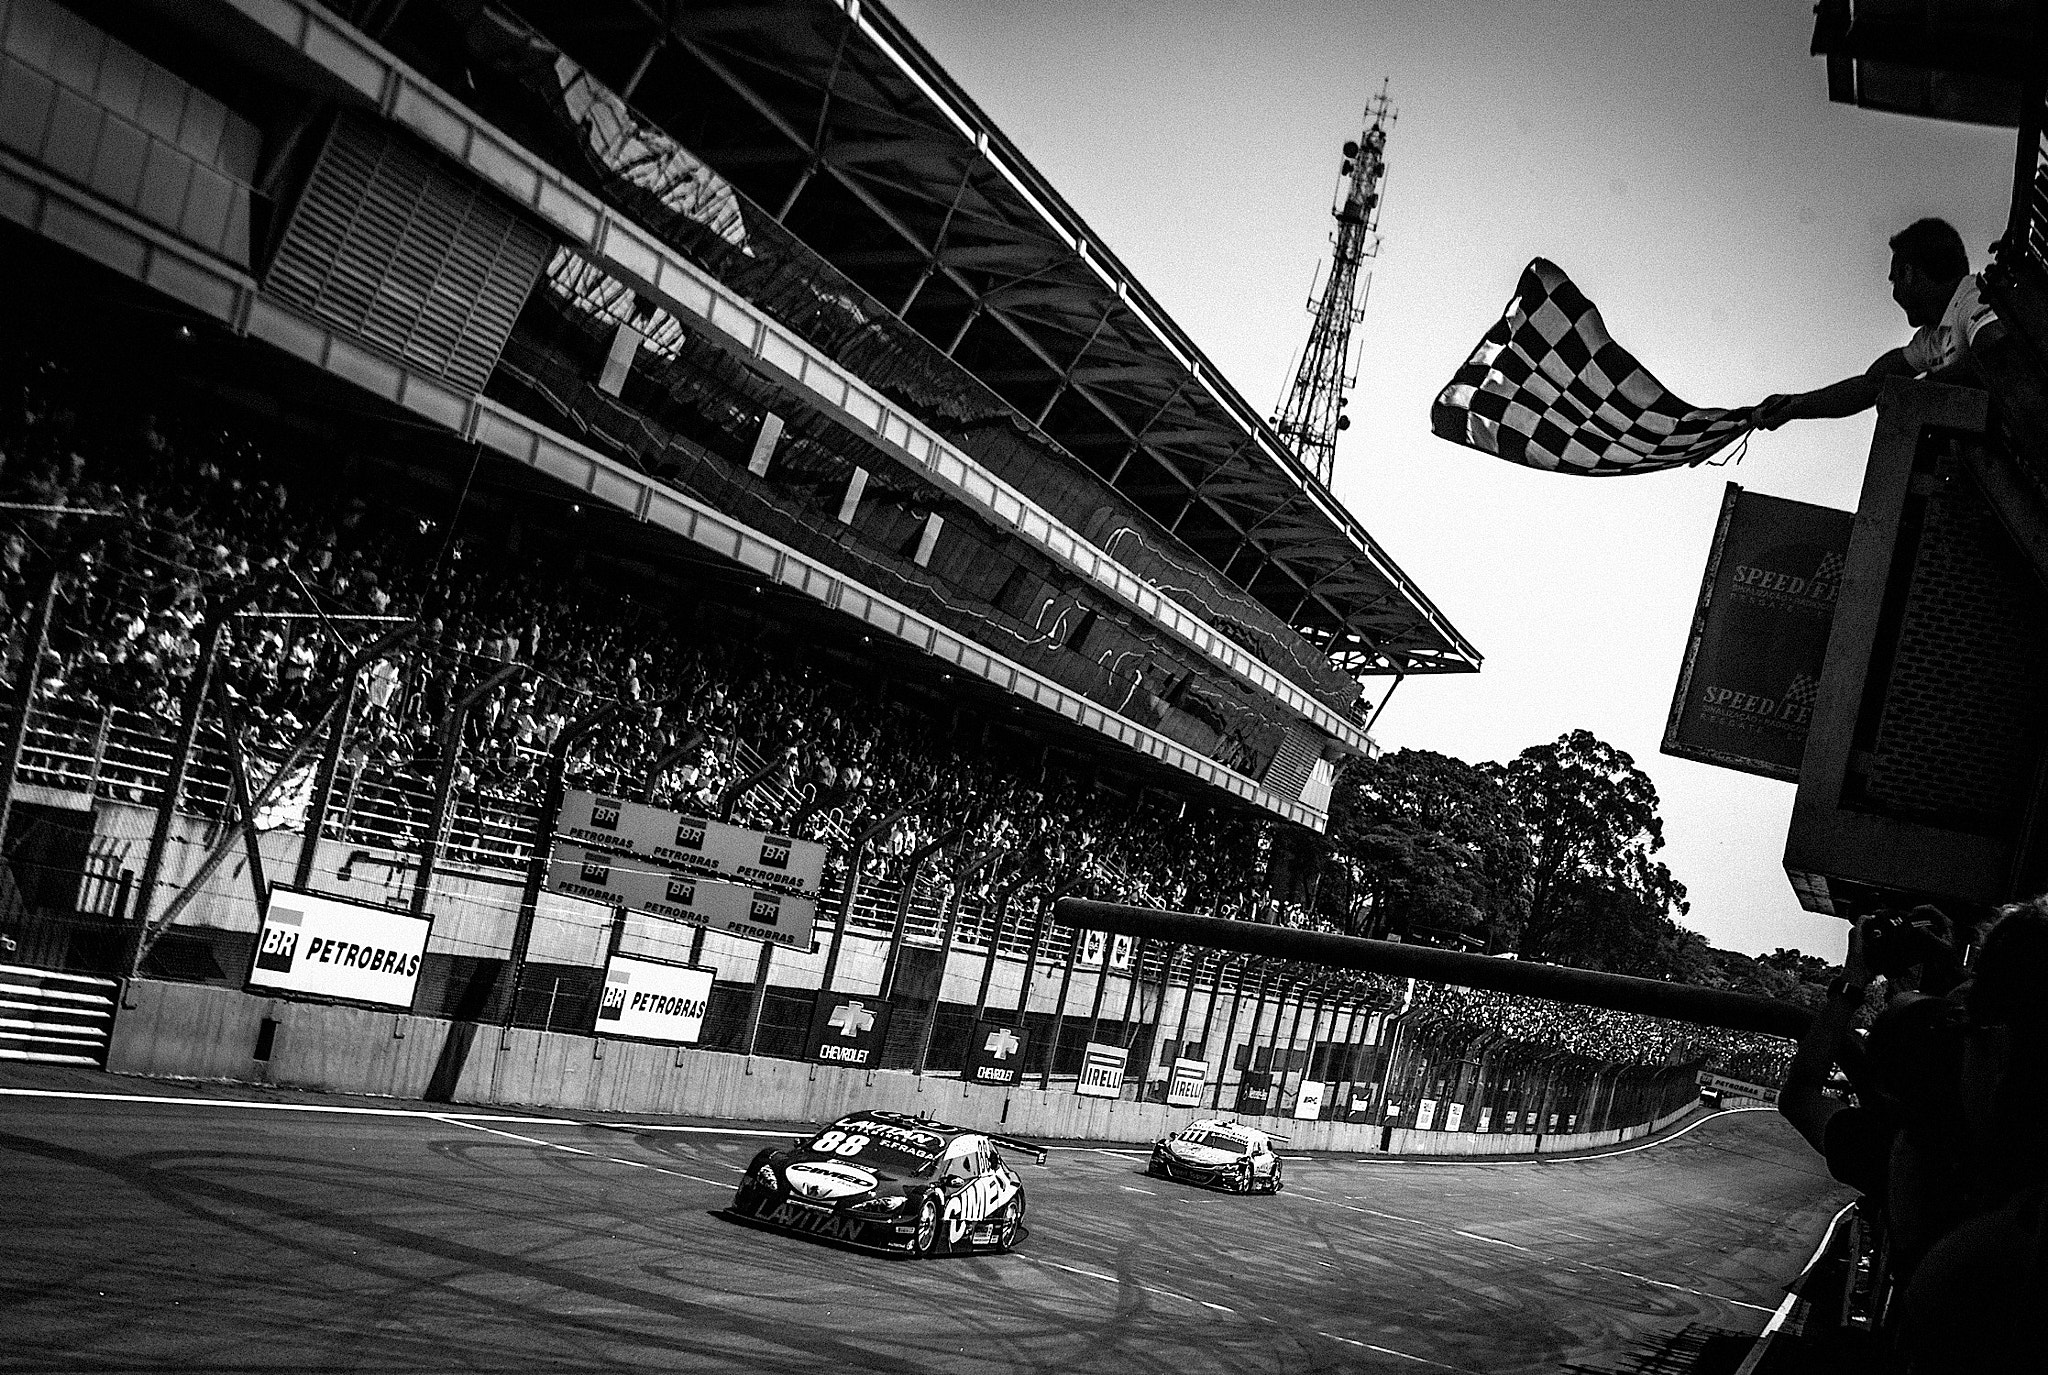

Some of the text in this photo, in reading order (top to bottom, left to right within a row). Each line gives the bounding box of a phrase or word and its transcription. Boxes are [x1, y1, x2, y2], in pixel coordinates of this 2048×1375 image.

[1732, 565, 1804, 595] SPEED
[1702, 685, 1775, 716] SPEED
[594, 808, 618, 823] BR
[570, 826, 634, 849] PETROBRAS
[679, 827, 703, 843] BR
[653, 846, 720, 869] PETROBRAS
[763, 846, 788, 862] BR
[736, 865, 805, 888] PETROBRAS
[558, 881, 624, 904] PETROBRAS
[668, 883, 693, 898] BR
[643, 901, 710, 924] PETROBRAS
[753, 902, 777, 918] BR
[727, 921, 795, 944] PETROBRAS
[262, 929, 420, 977] BR PETROBRAS
[603, 987, 706, 1019] BR PETROBRAS
[819, 1044, 870, 1064] CHEVROLET
[976, 1066, 1015, 1082] CHEVROLET
[1714, 1079, 1759, 1095] PETROBRAS
[835, 1118, 934, 1144] LAVITAN
[812, 1131, 870, 1156] 88
[791, 1165, 874, 1187] CIMED
[754, 1198, 865, 1241] LAVITAN
